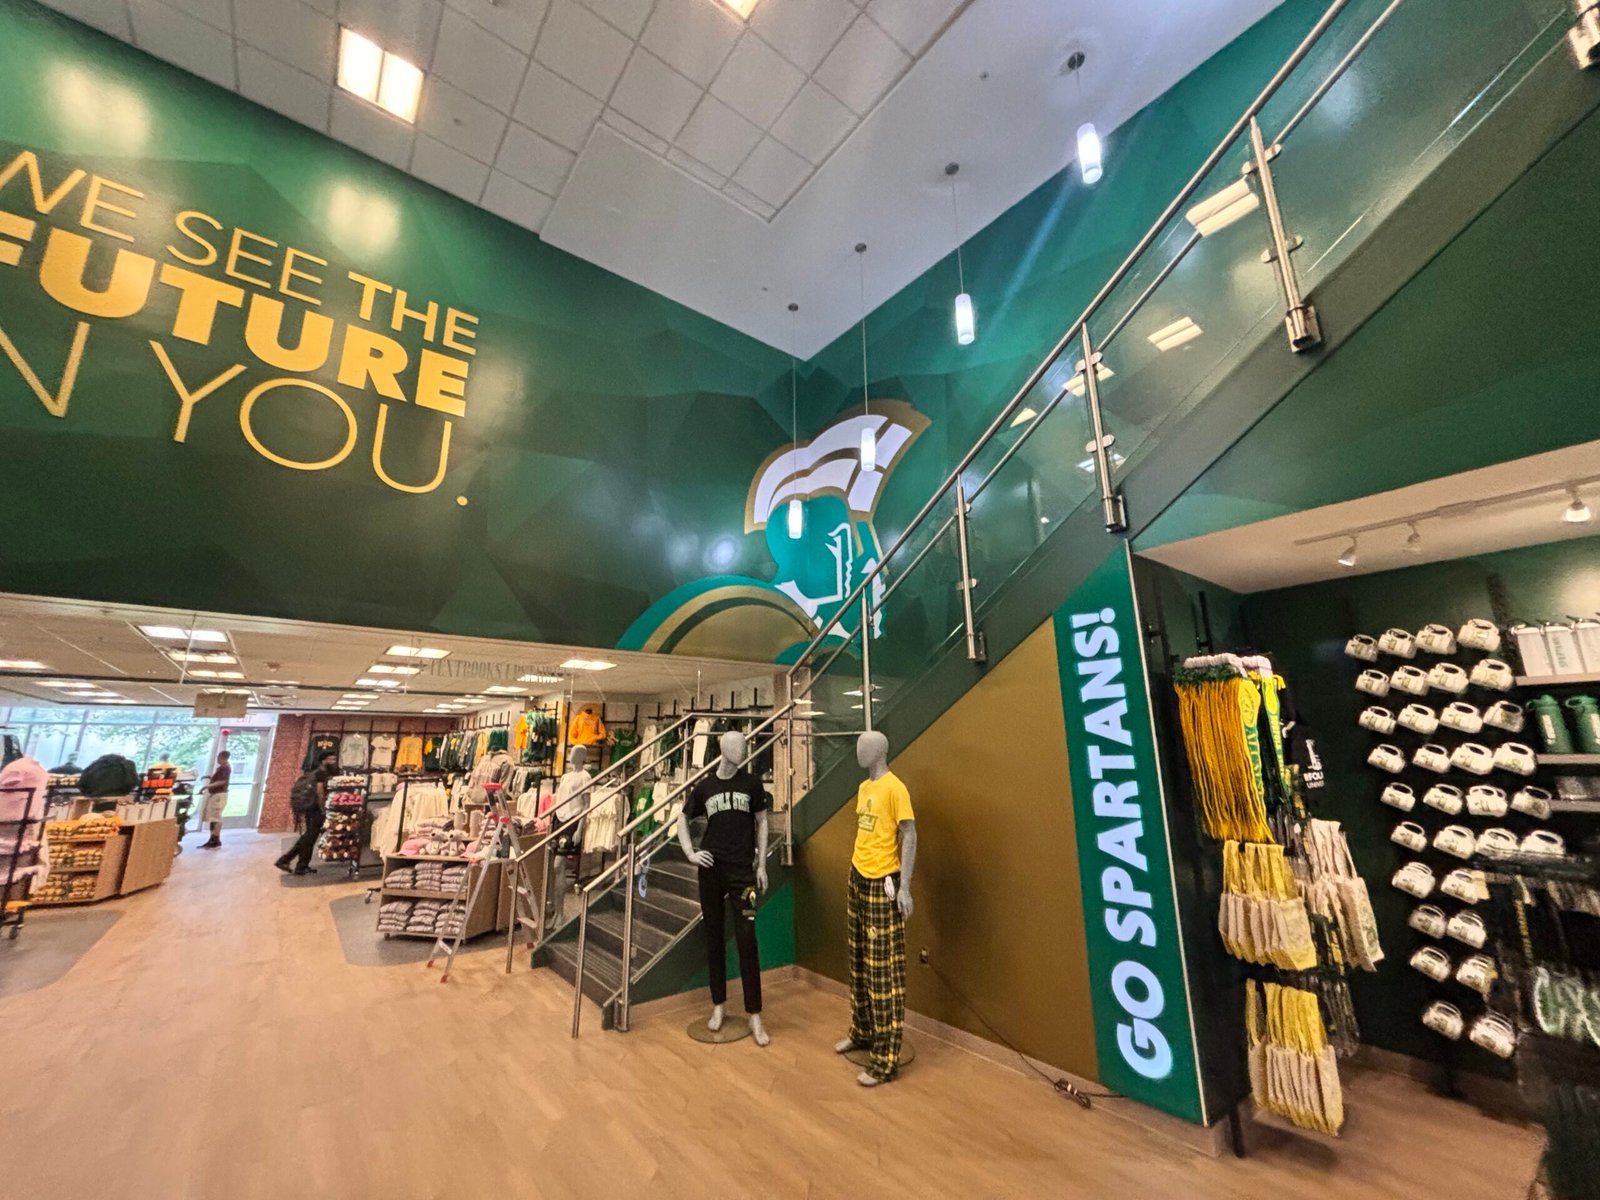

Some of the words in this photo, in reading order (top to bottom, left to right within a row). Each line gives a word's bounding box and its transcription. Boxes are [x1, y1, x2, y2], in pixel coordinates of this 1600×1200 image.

[0, 150, 145, 243] WE
[166, 210, 328, 306] SEE
[348, 271, 480, 355] THE
[0, 211, 470, 418] FUTURE
[149, 340, 468, 506] YOU.
[1069, 607, 1157, 947] SPARTANS!
[1111, 960, 1173, 1080] GO
